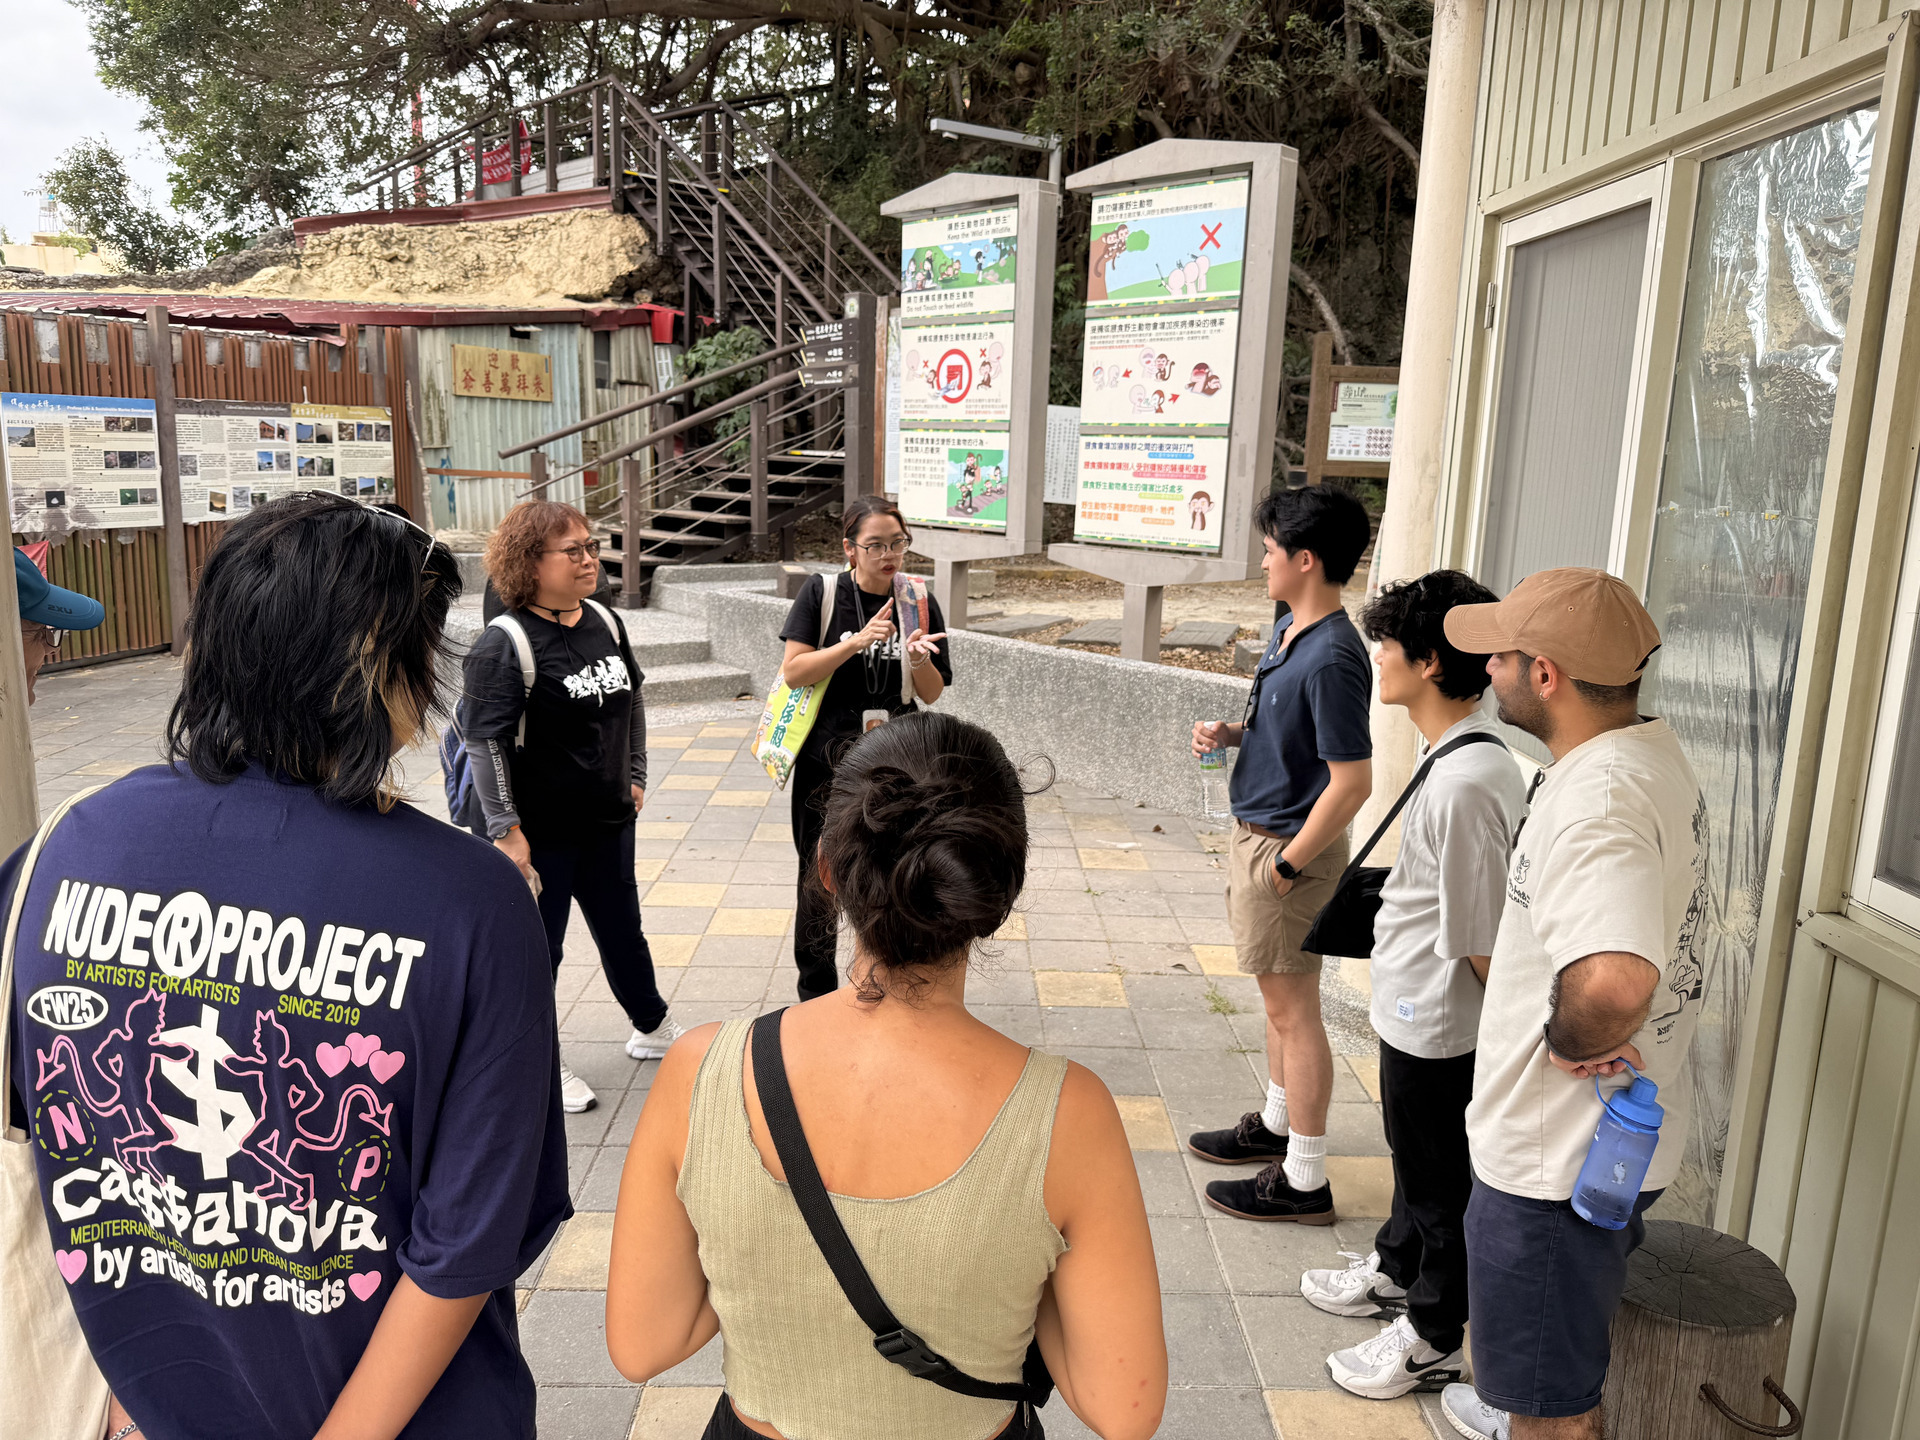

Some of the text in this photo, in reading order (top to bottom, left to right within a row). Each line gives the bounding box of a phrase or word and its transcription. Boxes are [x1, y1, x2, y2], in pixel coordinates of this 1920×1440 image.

[47, 604, 72, 614] 2XU
[66, 959, 241, 1005] BY ARTISTS FOR ARTISTS
[40, 991, 96, 1024] FW25
[277, 993, 361, 1027] SINCE 2019
[48, 1101, 87, 1150] N
[350, 1146, 381, 1192] P
[70, 1219, 354, 1281] MEDITERRANEAN HEDONISM AND URBAN RESILIENCE
[93, 1242, 346, 1315] by artists for artists
